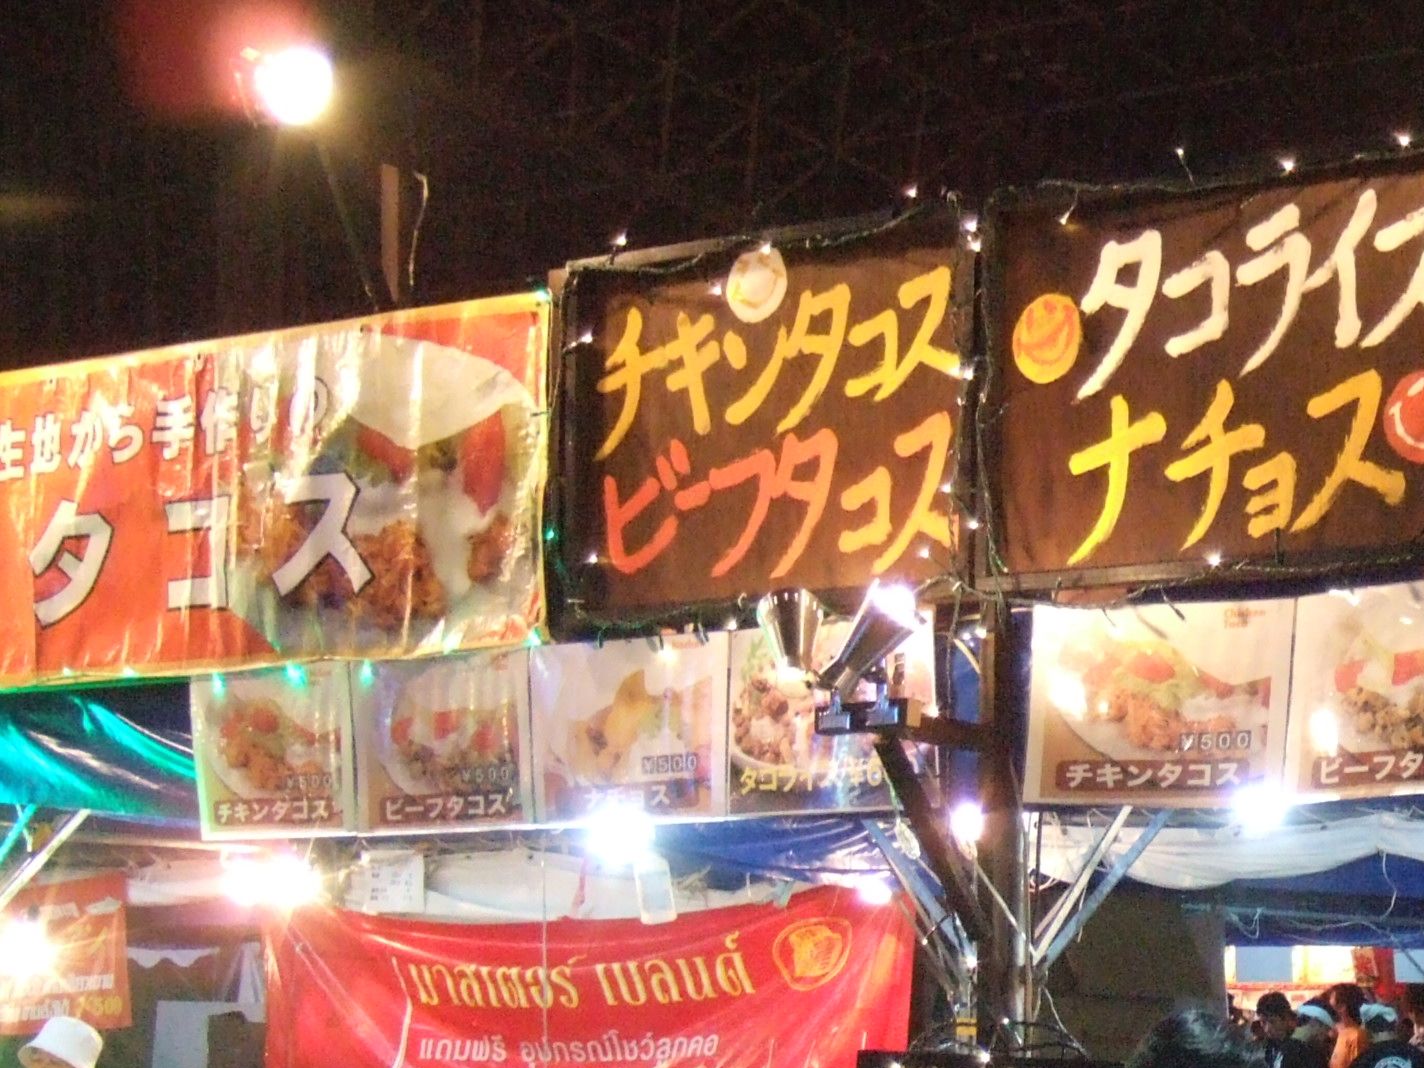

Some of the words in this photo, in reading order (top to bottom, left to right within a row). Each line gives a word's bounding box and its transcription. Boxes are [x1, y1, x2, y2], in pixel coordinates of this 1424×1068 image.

[594, 265, 964, 461] チキンタコス
[1067, 368, 1406, 565] ナチョス
[604, 411, 958, 578] ビーフタコス
[27, 471, 375, 630] タコス
[1180, 732, 1251, 750] ¥500
[642, 754, 698, 773] ¥500
[1065, 760, 1242, 787] チキンタコス
[461, 770, 511, 785] ¥500
[216, 800, 329, 823] チキンタコス
[385, 794, 507, 821] ビーフタコス
[408, 954, 589, 1009] มาสเตอร์
